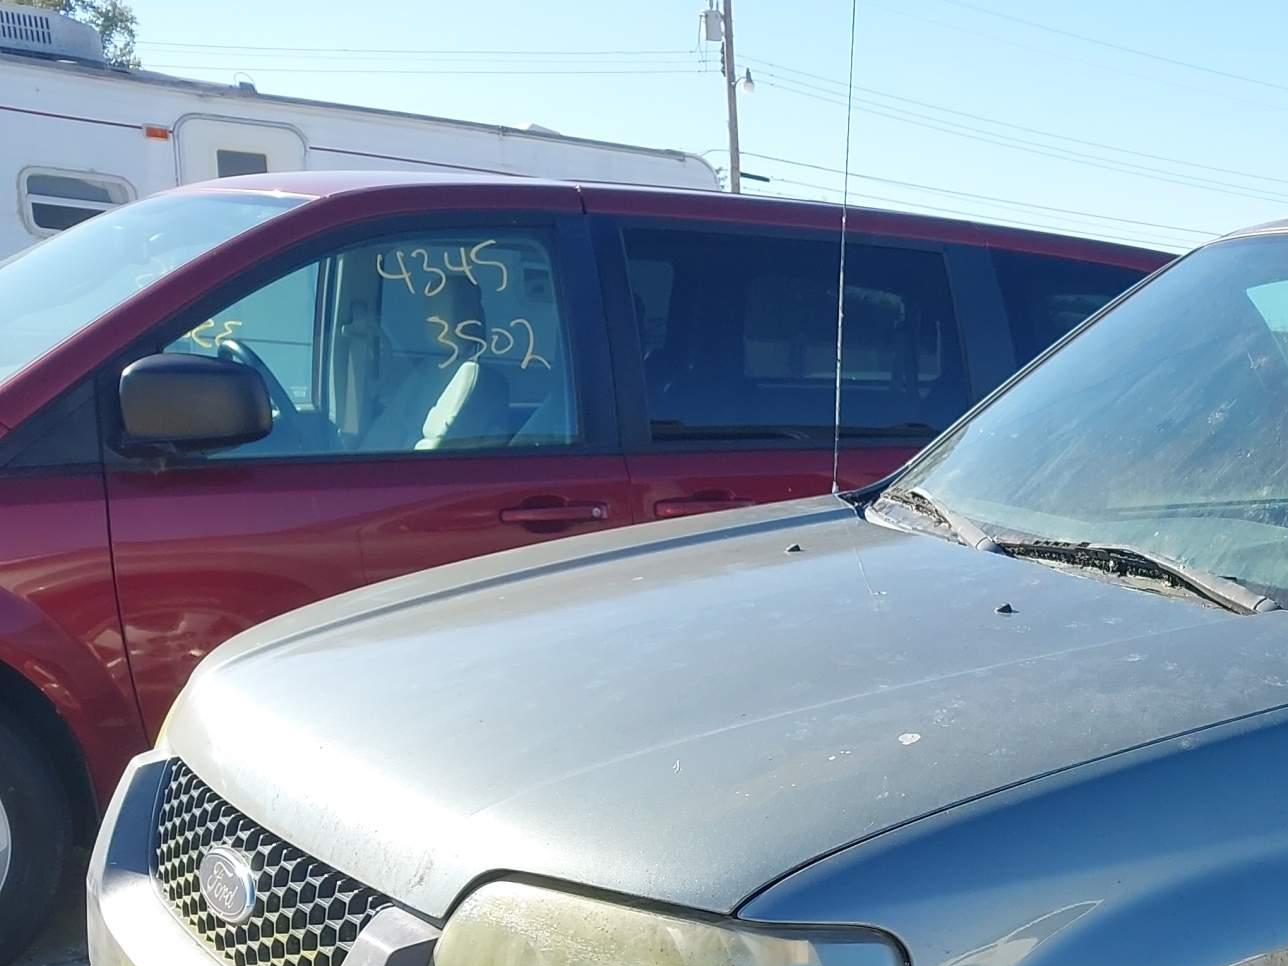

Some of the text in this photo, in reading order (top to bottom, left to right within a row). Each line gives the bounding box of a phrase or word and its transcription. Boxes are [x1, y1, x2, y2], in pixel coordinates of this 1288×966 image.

[376, 239, 508, 297] 4345
[426, 315, 552, 371] 3502
[203, 861, 239, 910] Ford
